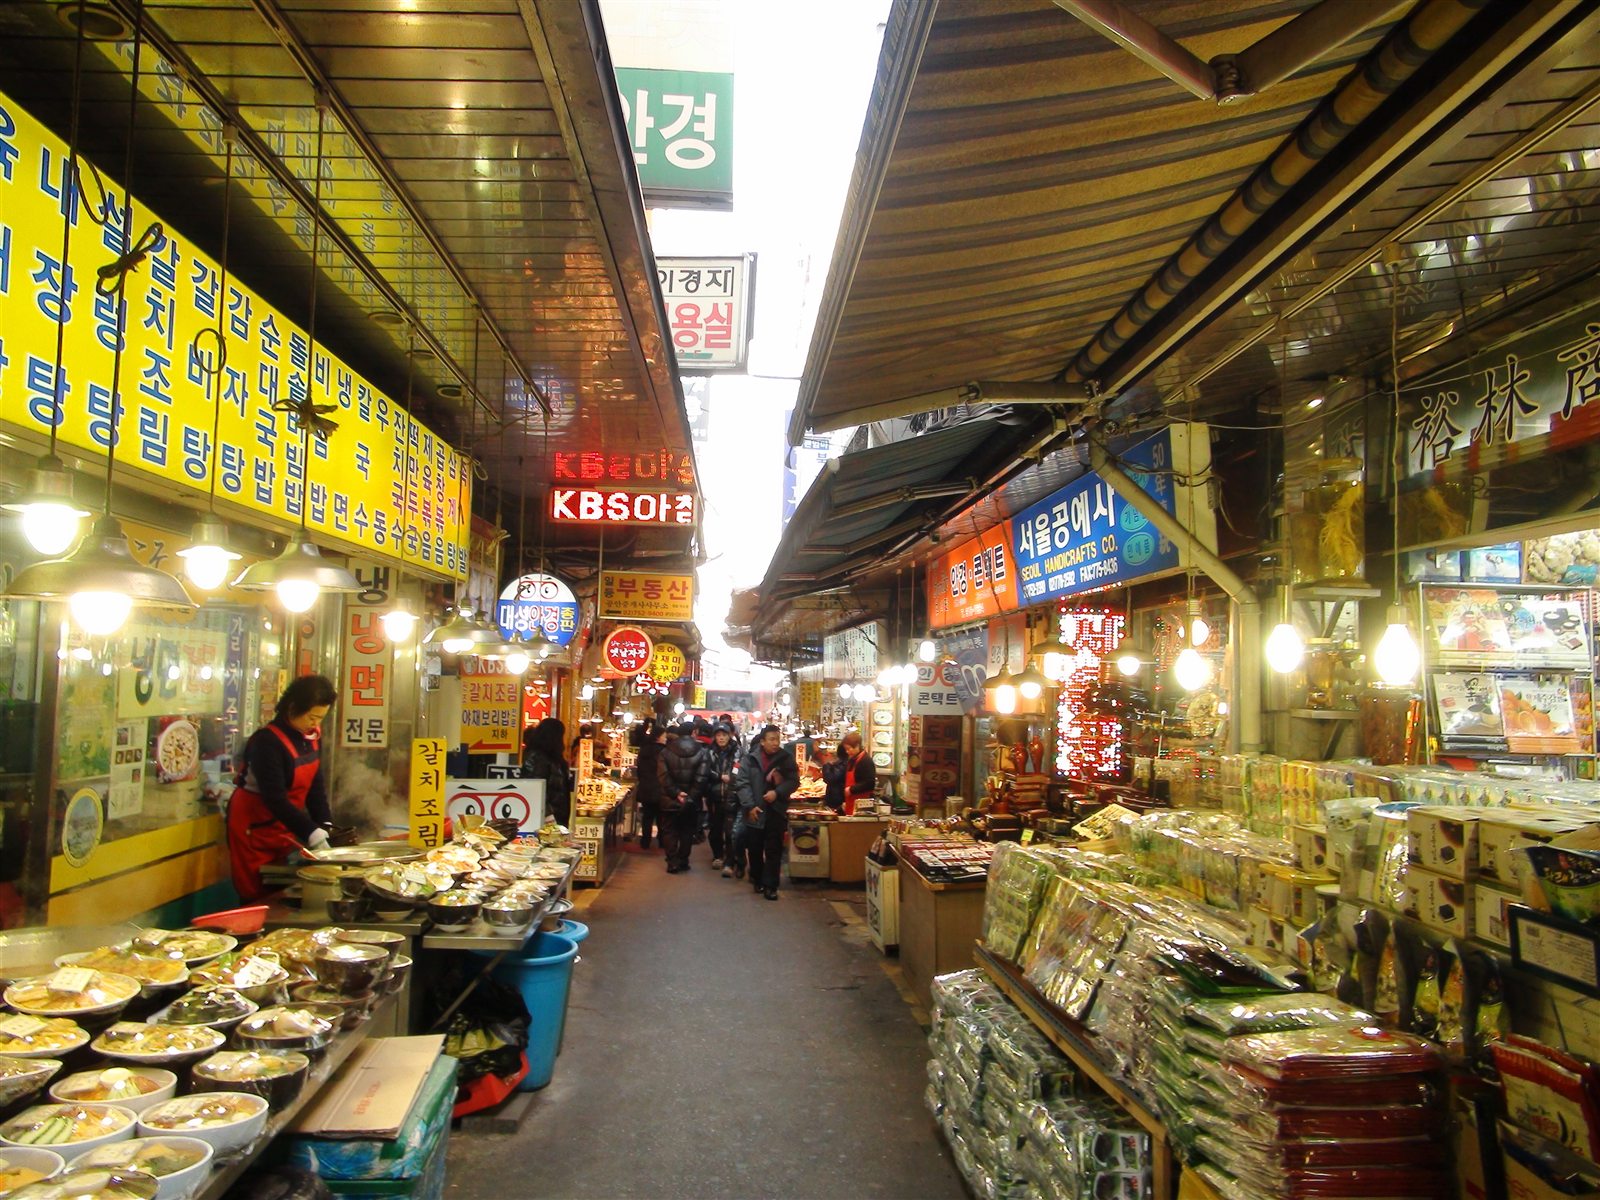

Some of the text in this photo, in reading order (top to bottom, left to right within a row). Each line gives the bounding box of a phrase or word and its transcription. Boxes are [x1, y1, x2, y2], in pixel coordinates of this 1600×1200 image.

[620, 89, 717, 169] 안경
[27, 146, 80, 427] 내장탕
[88, 191, 132, 448] 설렁탕
[139, 226, 180, 468] 갈치조림
[183, 258, 219, 481] 갈비탕
[221, 286, 252, 493] 감자탕
[254, 313, 282, 505] 순대국밥
[284, 331, 309, 517] 돌솥비빔밥
[333, 367, 352, 532] 냉면
[354, 383, 372, 538] 칼국수
[373, 397, 389, 545] 우동
[391, 410, 406, 550] 잔치국수
[407, 421, 420, 554] 떡만두국
[422, 433, 433, 561] 제육볶음
[435, 441, 446, 566] 곱창볶음
[447, 451, 457, 570] 삼계탕
[1019, 482, 1116, 560] 서울공예사
[1021, 534, 1118, 581] SEOUL HANDICRAFTS CO.
[355, 566, 390, 604] 냉
[500, 605, 560, 633] 대성안경
[617, 578, 689, 600] 부동산
[350, 612, 386, 707] 냉면
[470, 682, 518, 703] 갈치조림
[919, 692, 957, 705] 콘택트
[345, 718, 385, 744] 전문
[492, 729, 508, 739] 지하
[414, 741, 443, 848] 갈치조림
[575, 826, 599, 838] 리밥
